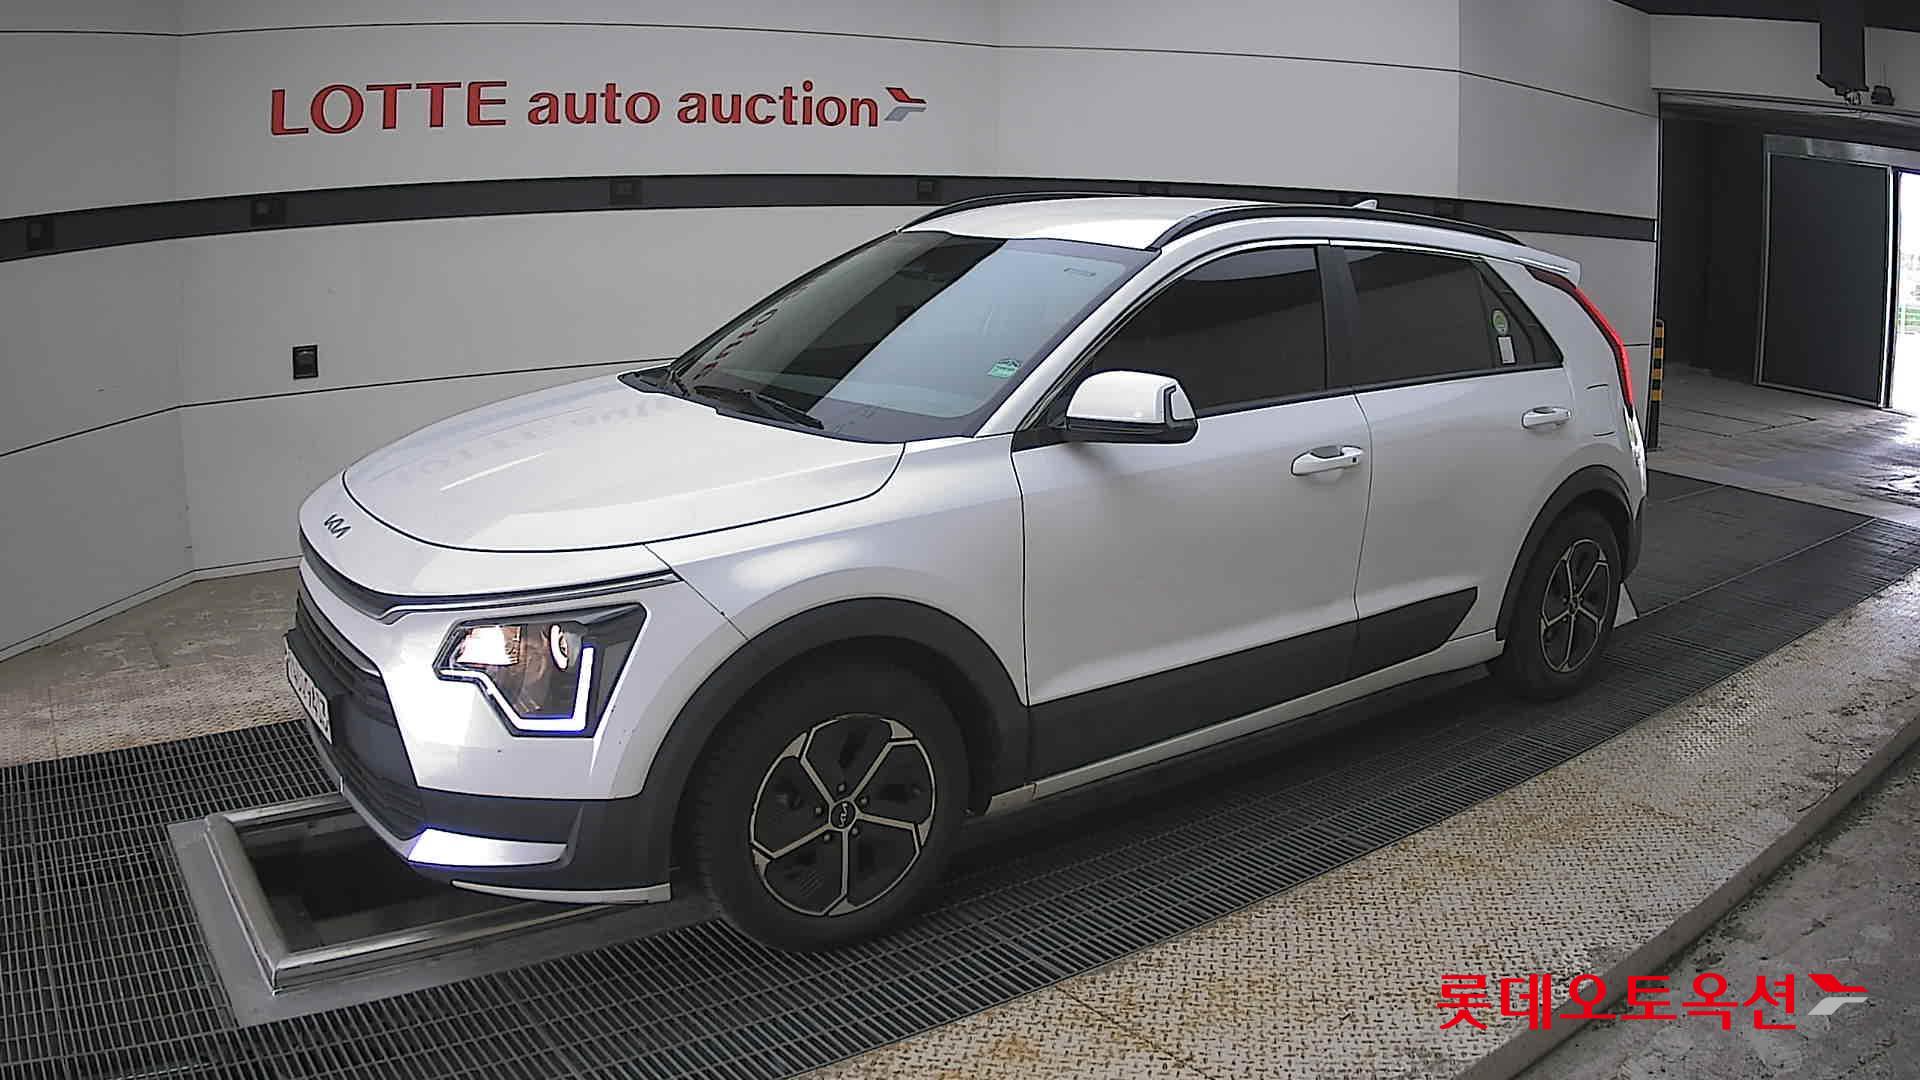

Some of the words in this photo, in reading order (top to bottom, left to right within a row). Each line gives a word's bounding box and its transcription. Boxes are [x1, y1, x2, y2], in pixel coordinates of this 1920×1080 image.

[270, 80, 508, 136] LOTTE
[527, 82, 662, 126] auto
[676, 80, 879, 127] auction
